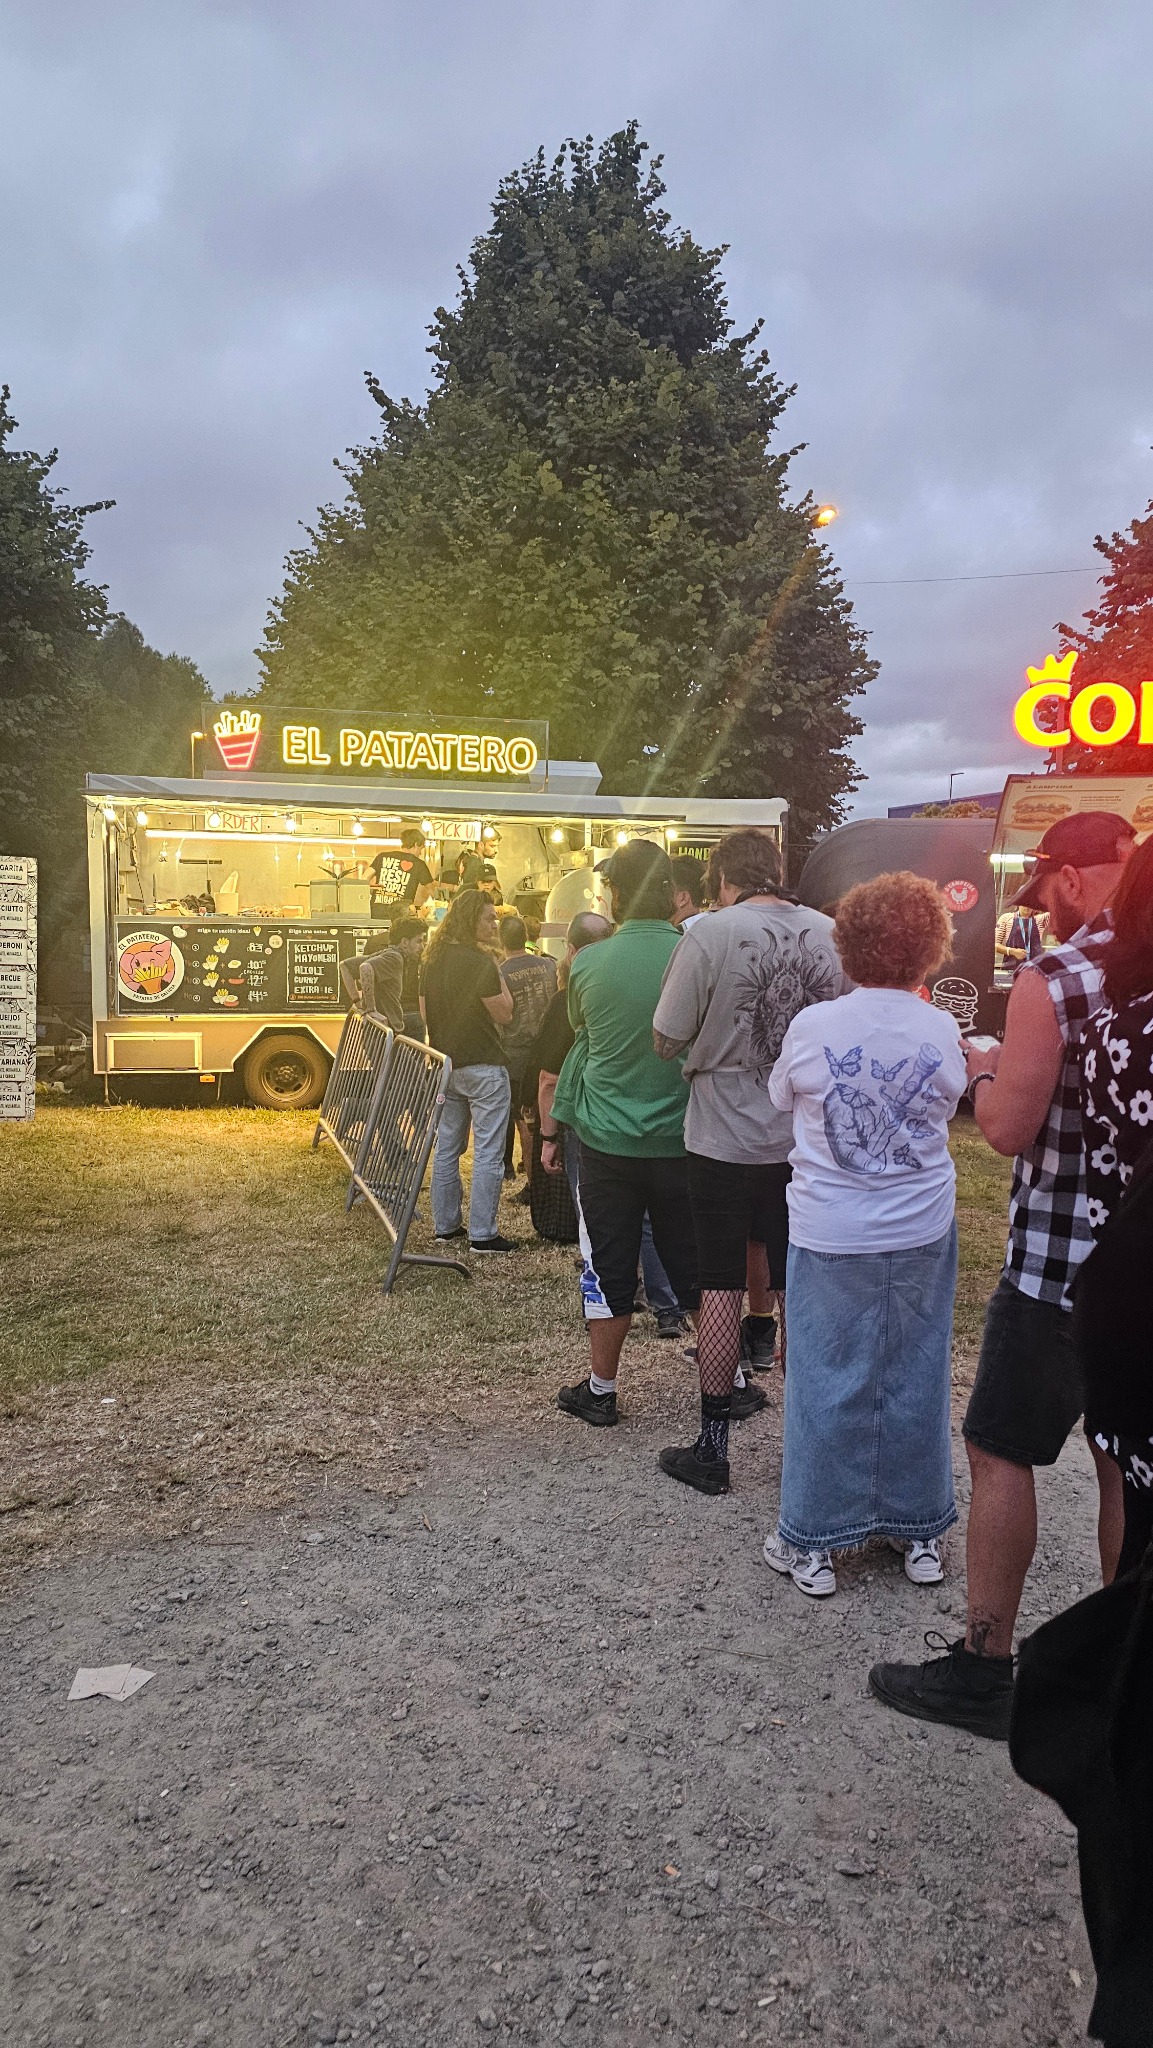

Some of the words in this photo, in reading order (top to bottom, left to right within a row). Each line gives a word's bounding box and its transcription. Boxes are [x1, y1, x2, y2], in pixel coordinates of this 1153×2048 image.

[282, 725, 331, 765] EL
[339, 728, 538, 774] PATATERO
[432, 821, 462, 838] PICK
[382, 856, 401, 870] WE
[0, 864, 24, 872] GARITA
[379, 867, 411, 886] RESU
[0, 905, 24, 913] CIUTTO
[118, 943, 127, 951] EL
[126, 933, 160, 944] PATATERO
[294, 944, 334, 953] KETCHUP
[0, 974, 21, 982] BECUE
[293, 976, 319, 984] CURRY
[0, 1014, 20, 1022] UEIJOS
[0, 1058, 26, 1066] ARIANA
[0, 1094, 21, 1102] ECINA
